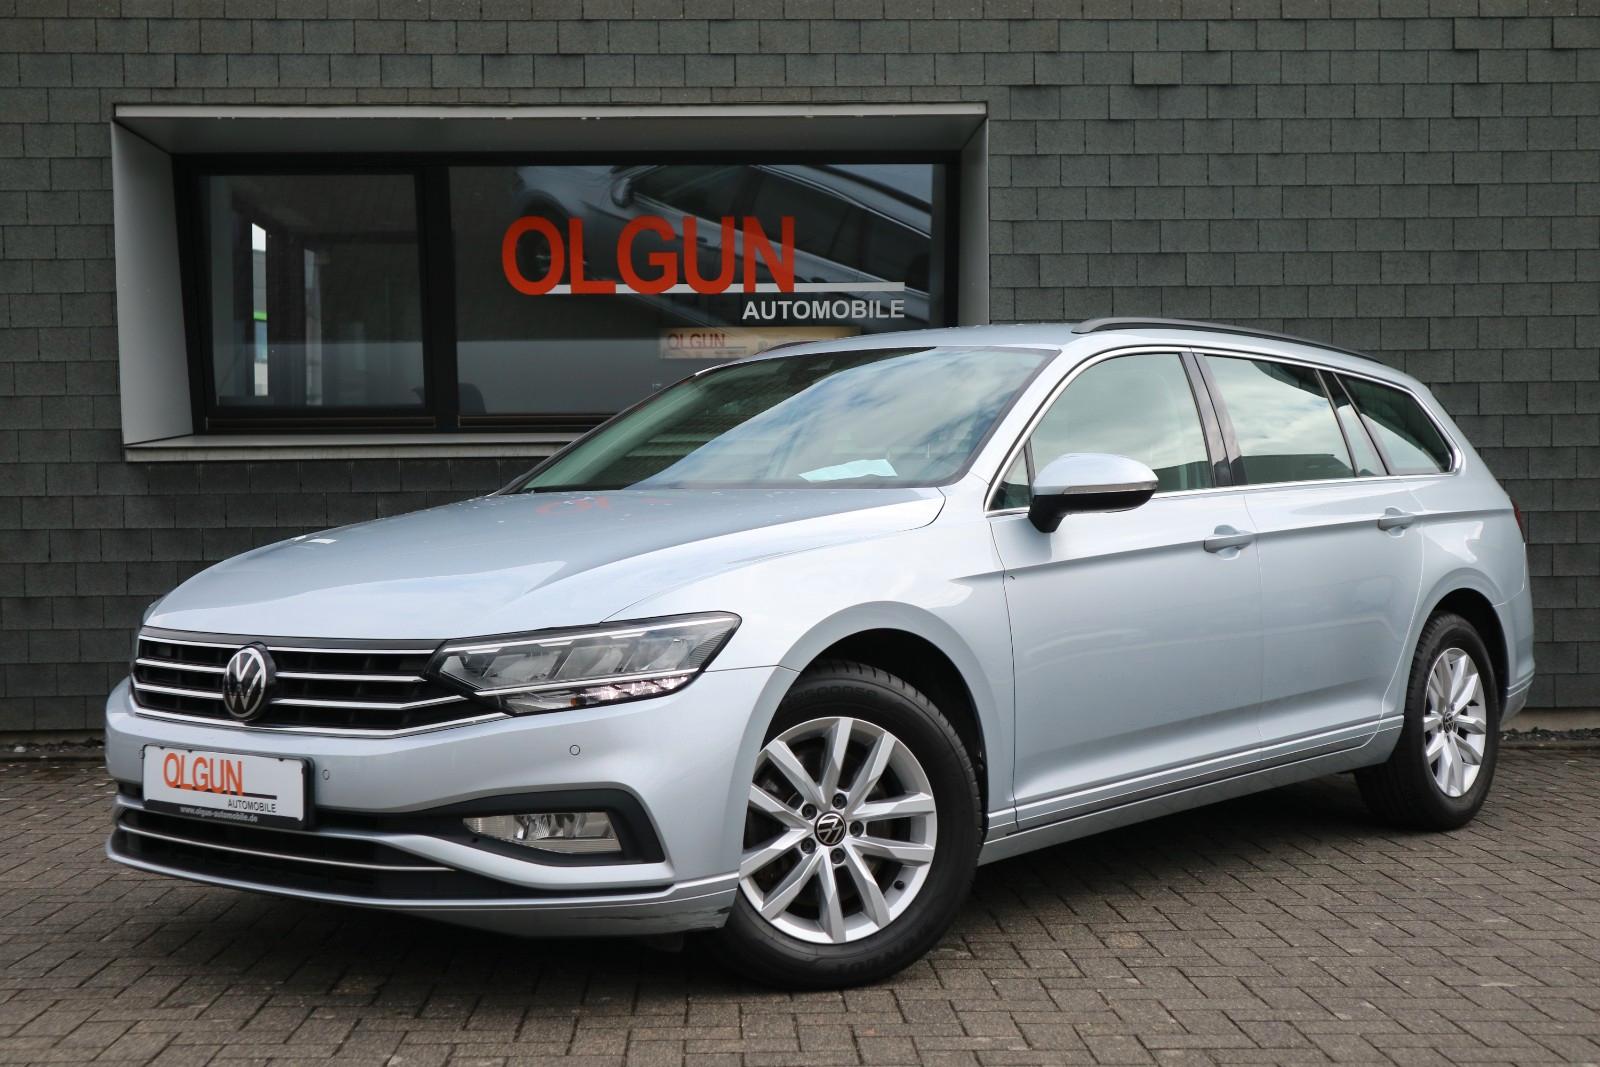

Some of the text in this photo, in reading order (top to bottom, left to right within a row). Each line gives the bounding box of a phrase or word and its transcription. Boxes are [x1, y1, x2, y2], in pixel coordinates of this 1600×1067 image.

[502, 216, 795, 296] OLGUN
[742, 299, 905, 320] AUTOMOBILE
[163, 752, 244, 797] OLGUN
[227, 799, 278, 813] AUTOMOBILE
